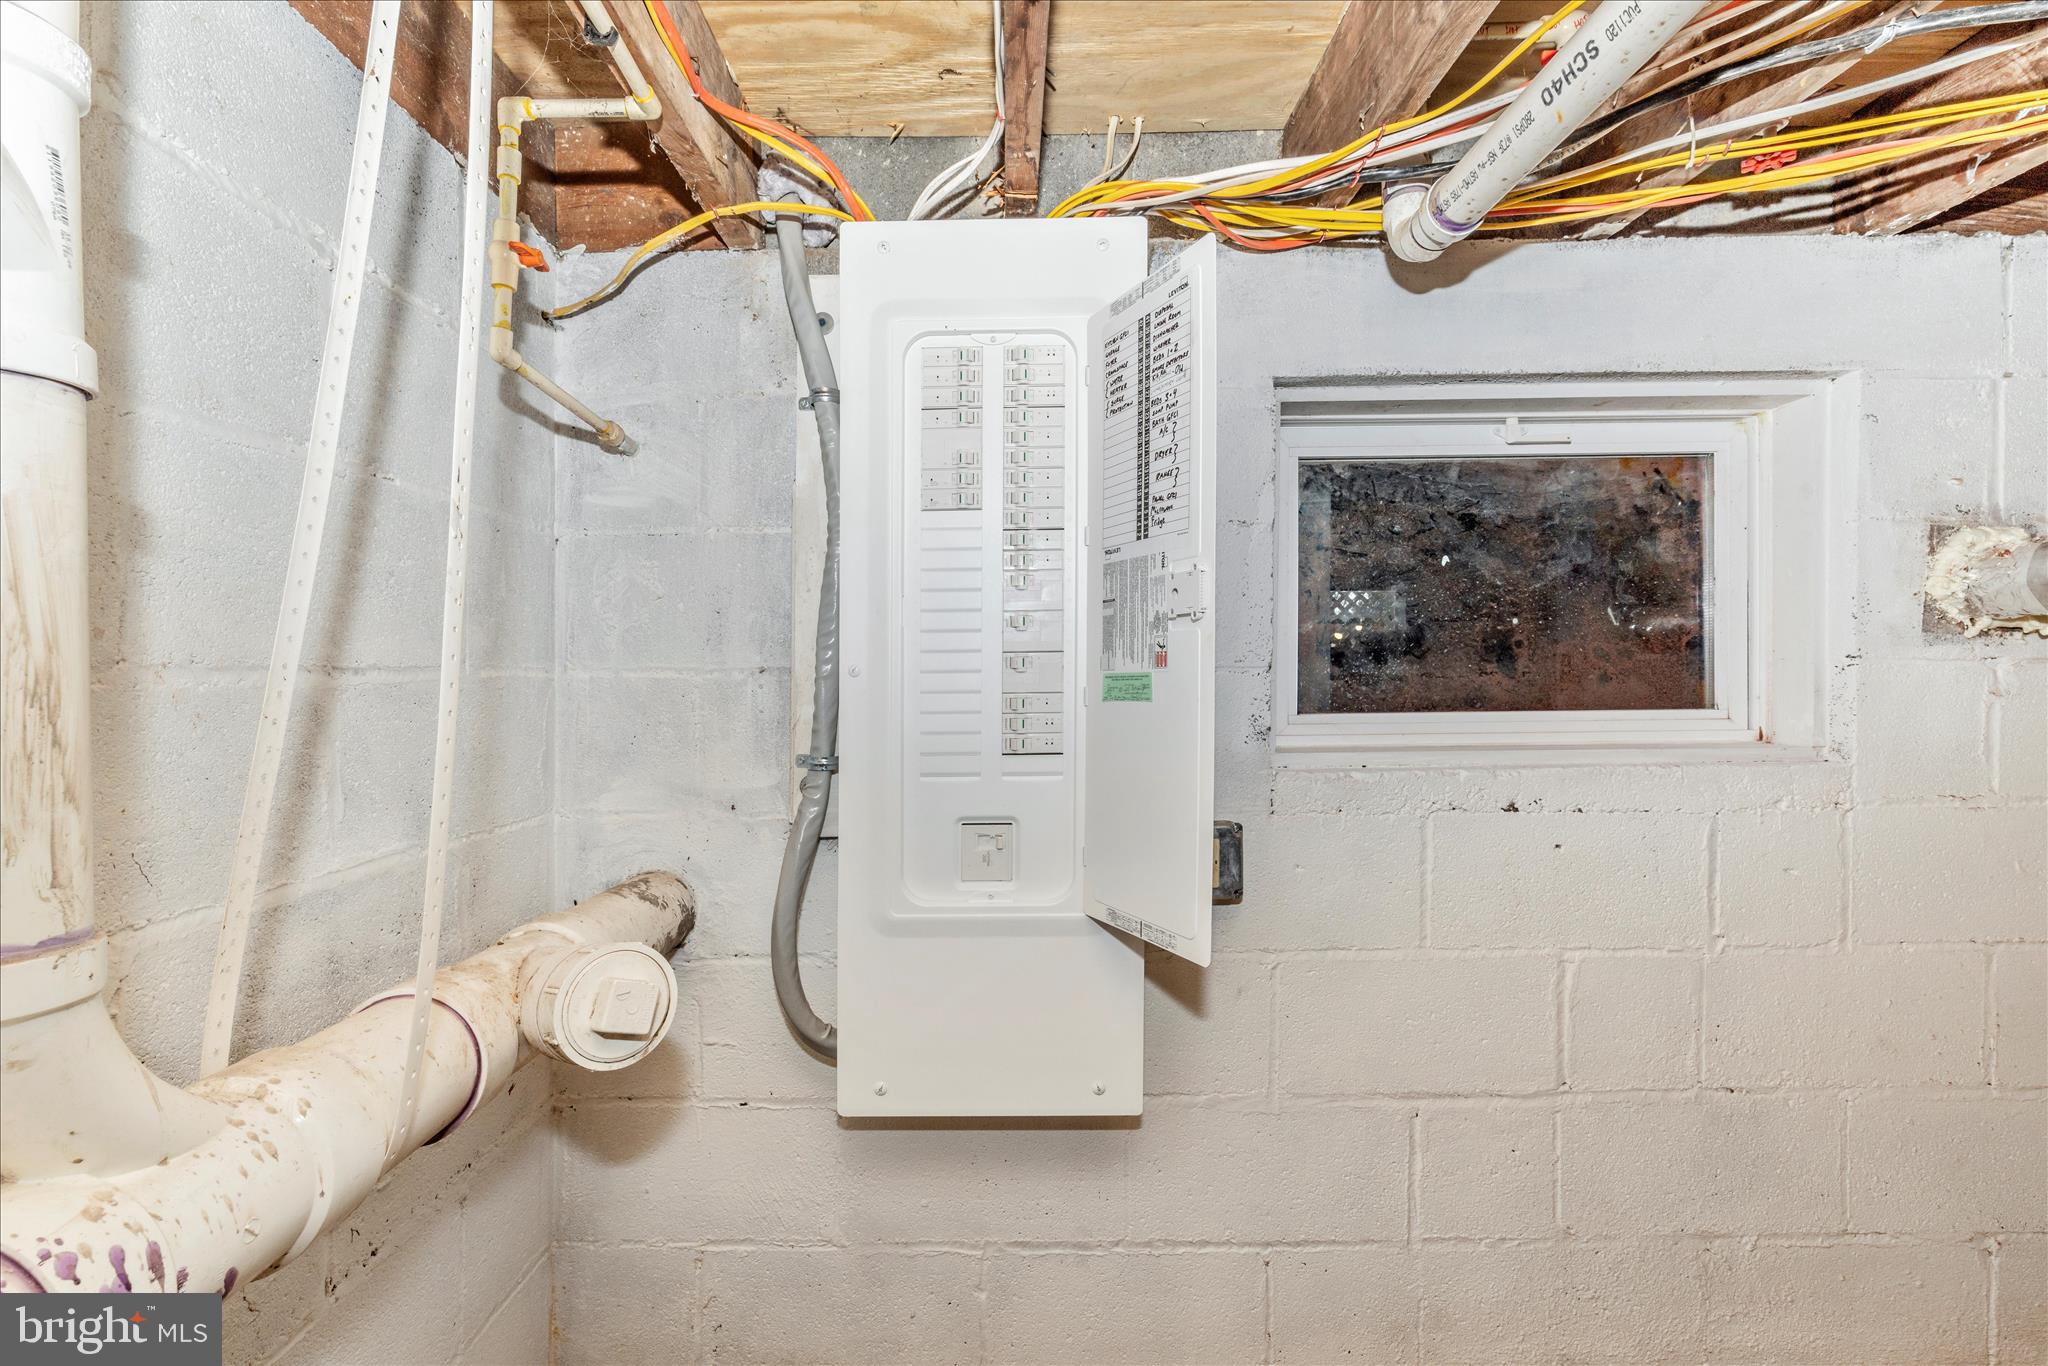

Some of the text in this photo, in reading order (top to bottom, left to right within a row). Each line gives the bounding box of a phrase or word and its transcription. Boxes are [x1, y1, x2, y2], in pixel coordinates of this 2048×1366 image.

[1541, 39, 1600, 107] SCH40
[1512, 110, 1535, 138] 280PSI
[1169, 281, 1189, 298] LEVITON
